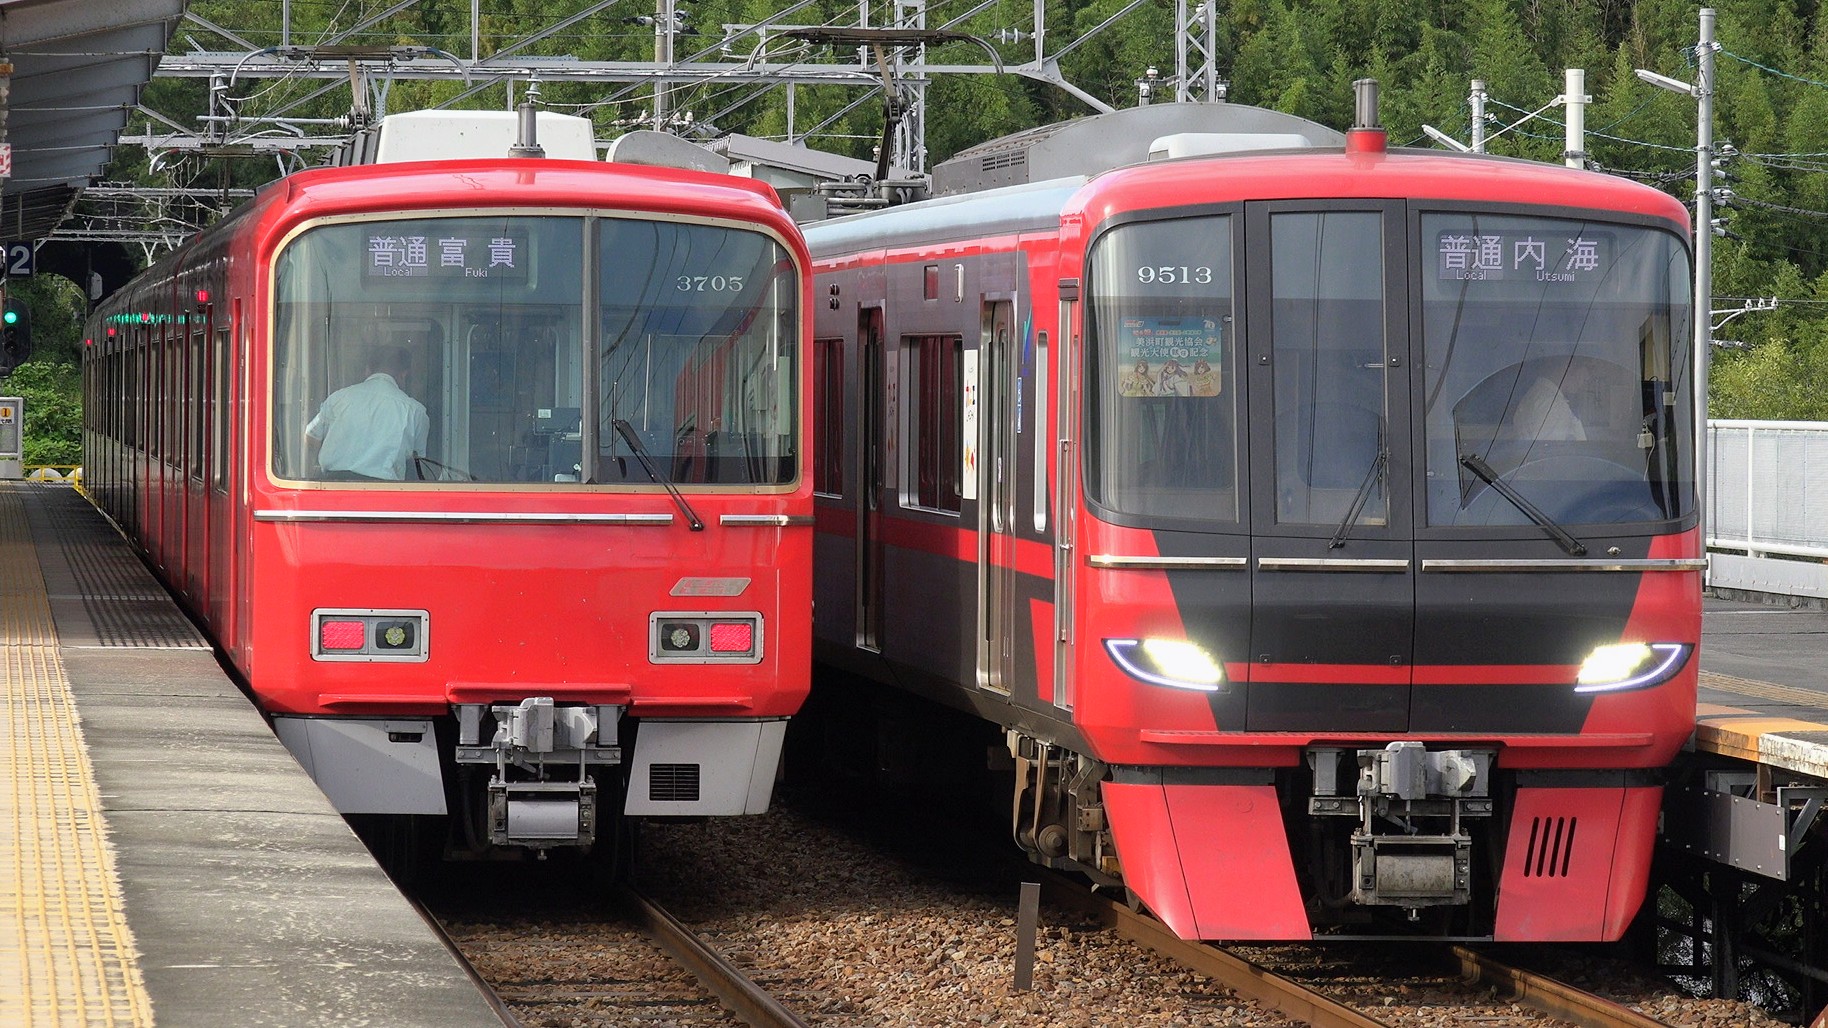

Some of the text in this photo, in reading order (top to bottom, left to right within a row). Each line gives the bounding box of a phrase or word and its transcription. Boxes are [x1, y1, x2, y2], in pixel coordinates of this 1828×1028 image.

[9, 245, 30, 275] 2
[368, 236, 427, 267] 普通
[1440, 235, 1598, 271] 普通 内海
[384, 266, 488, 278] Local Fuki
[1137, 266, 1212, 284] 9513
[1456, 269, 1575, 282] Local Utsumi
[677, 275, 744, 292] 3705
